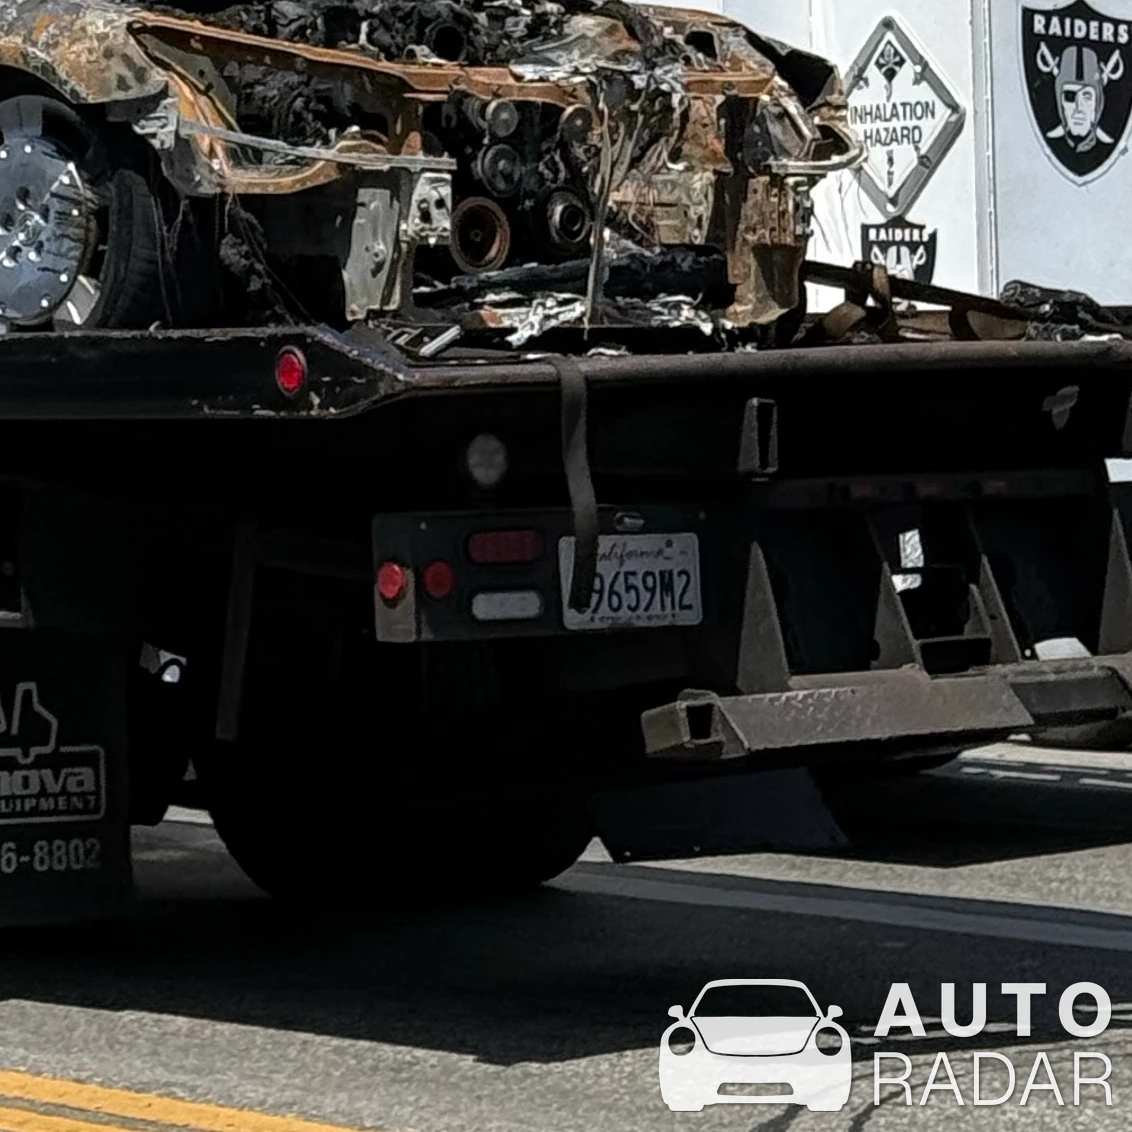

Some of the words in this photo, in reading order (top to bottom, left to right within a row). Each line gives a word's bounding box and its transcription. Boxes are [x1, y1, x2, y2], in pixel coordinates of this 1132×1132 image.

[1033, 13, 1130, 45] RAIDERS
[850, 99, 936, 125] INHALATION
[863, 125, 923, 148] HAZARD
[868, 227, 930, 243] RAIDERS
